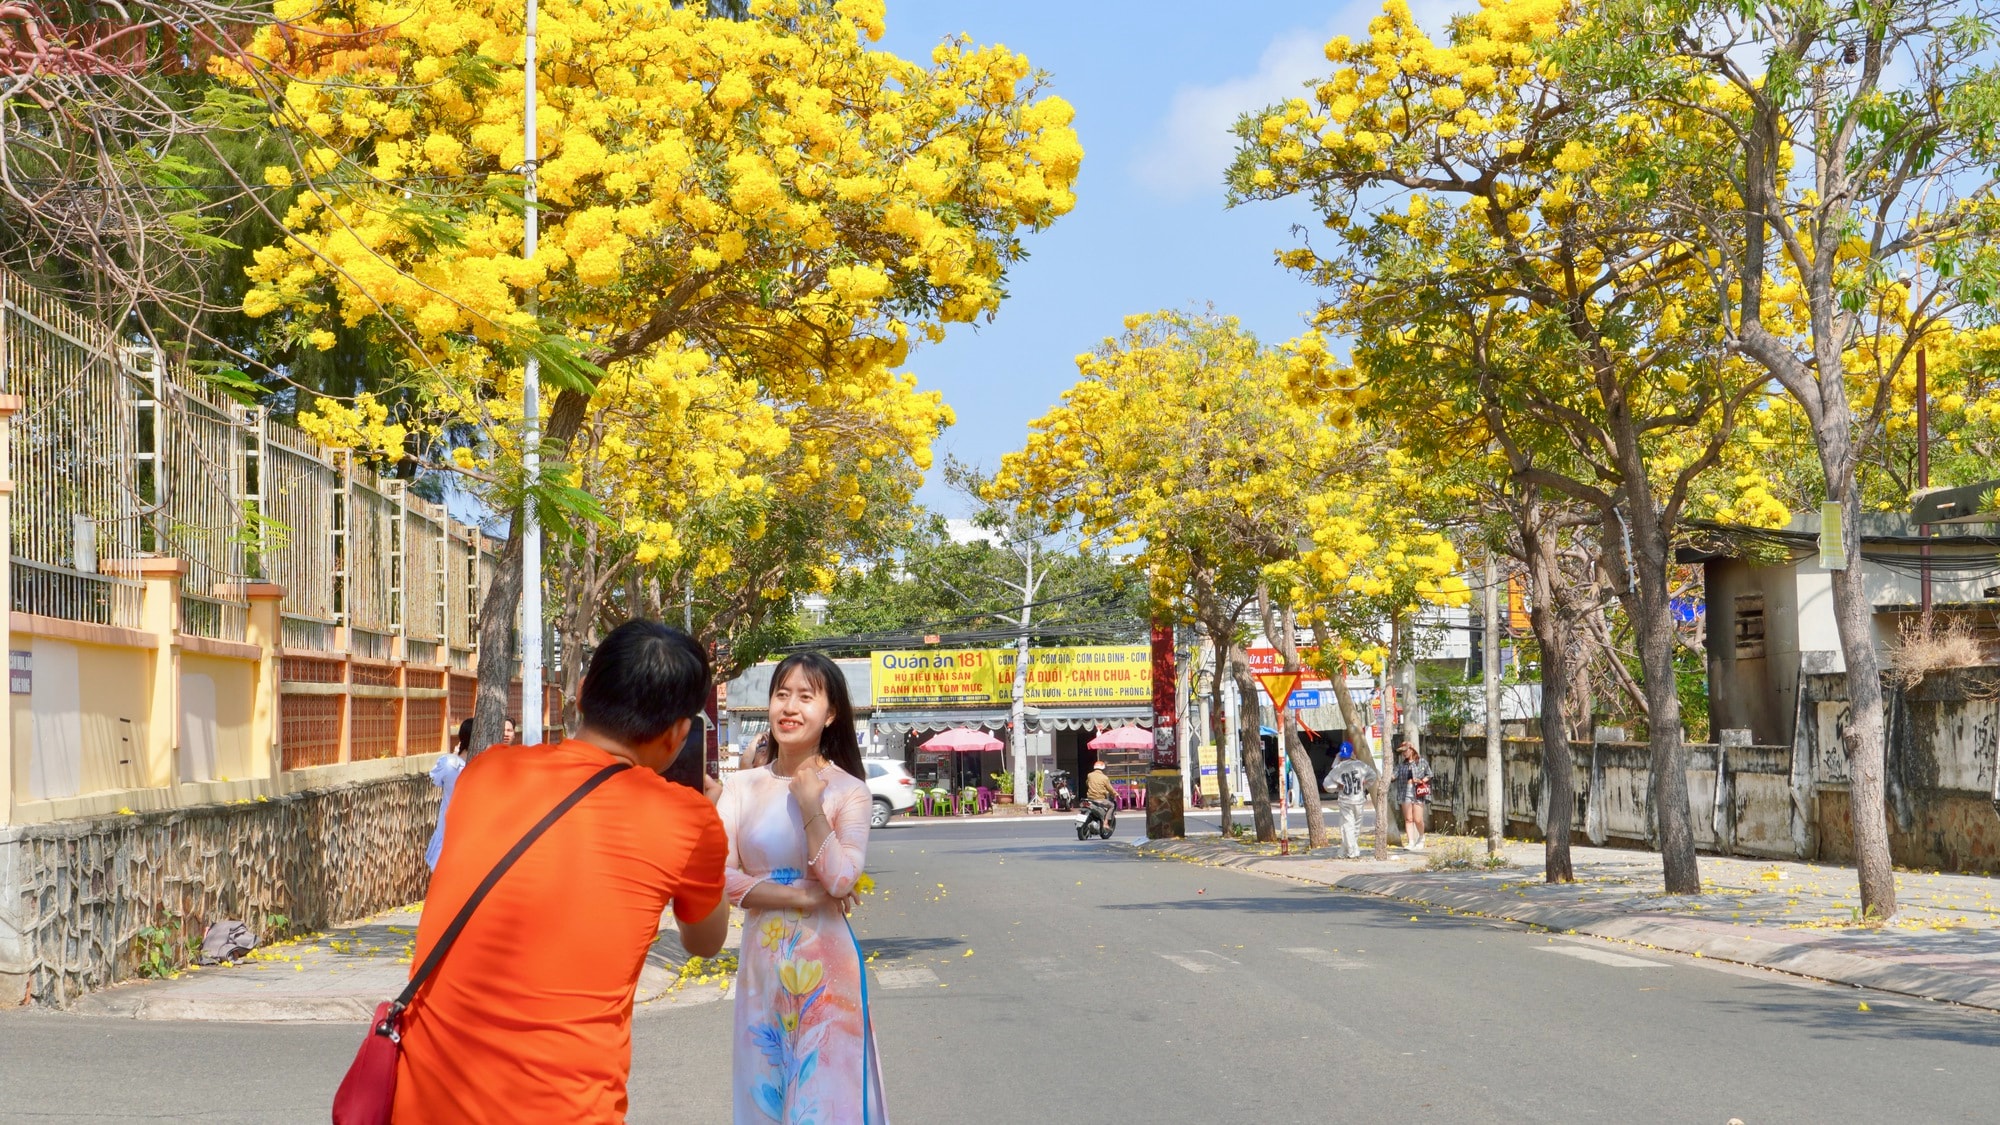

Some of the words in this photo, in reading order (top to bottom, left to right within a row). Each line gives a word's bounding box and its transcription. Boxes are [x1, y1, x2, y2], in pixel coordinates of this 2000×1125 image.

[882, 654, 929, 669] Quán
[933, 653, 954, 669] ăn
[957, 652, 983, 667] 181
[998, 654, 1013, 665] CƠM
[1040, 653, 1056, 665] CƠM
[1076, 652, 1092, 664] CƠM
[1094, 652, 1106, 663] GIA
[1107, 651, 1125, 663] ĐÌNH
[1130, 652, 1146, 663] CƠM
[1249, 653, 1261, 664] ỬA
[1263, 655, 1272, 664] XE
[1072, 669, 1100, 682] CANH
[1104, 669, 1131, 681] CHUA
[1079, 686, 1092, 697] PHÊ
[1297, 699, 1305, 707] THỊ
[1306, 697, 1318, 706] SÁU
